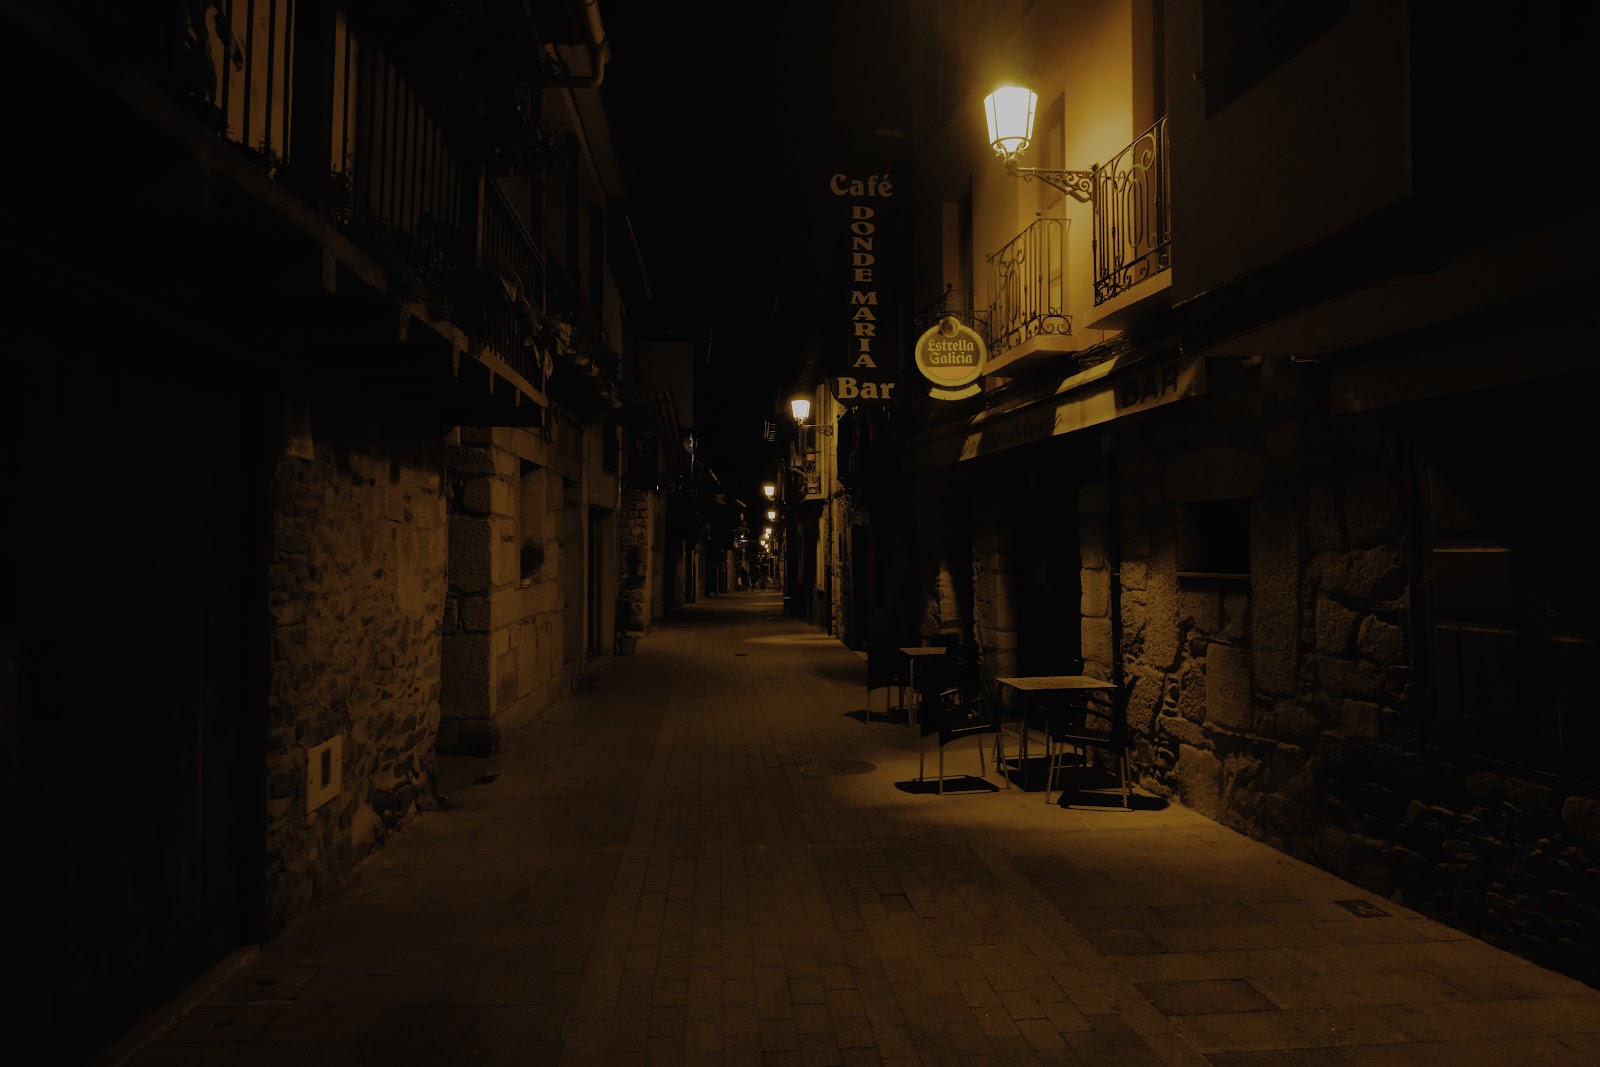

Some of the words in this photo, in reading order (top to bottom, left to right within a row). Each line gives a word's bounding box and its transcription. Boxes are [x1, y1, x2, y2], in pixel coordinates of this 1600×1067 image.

[830, 174, 893, 197] Café
[850, 206, 875, 282] DONDE
[850, 291, 878, 367] MARIA
[928, 339, 974, 352] Estrella
[930, 352, 972, 364] Galicia
[837, 377, 895, 399] Bar
[1121, 366, 1179, 405] BAR
